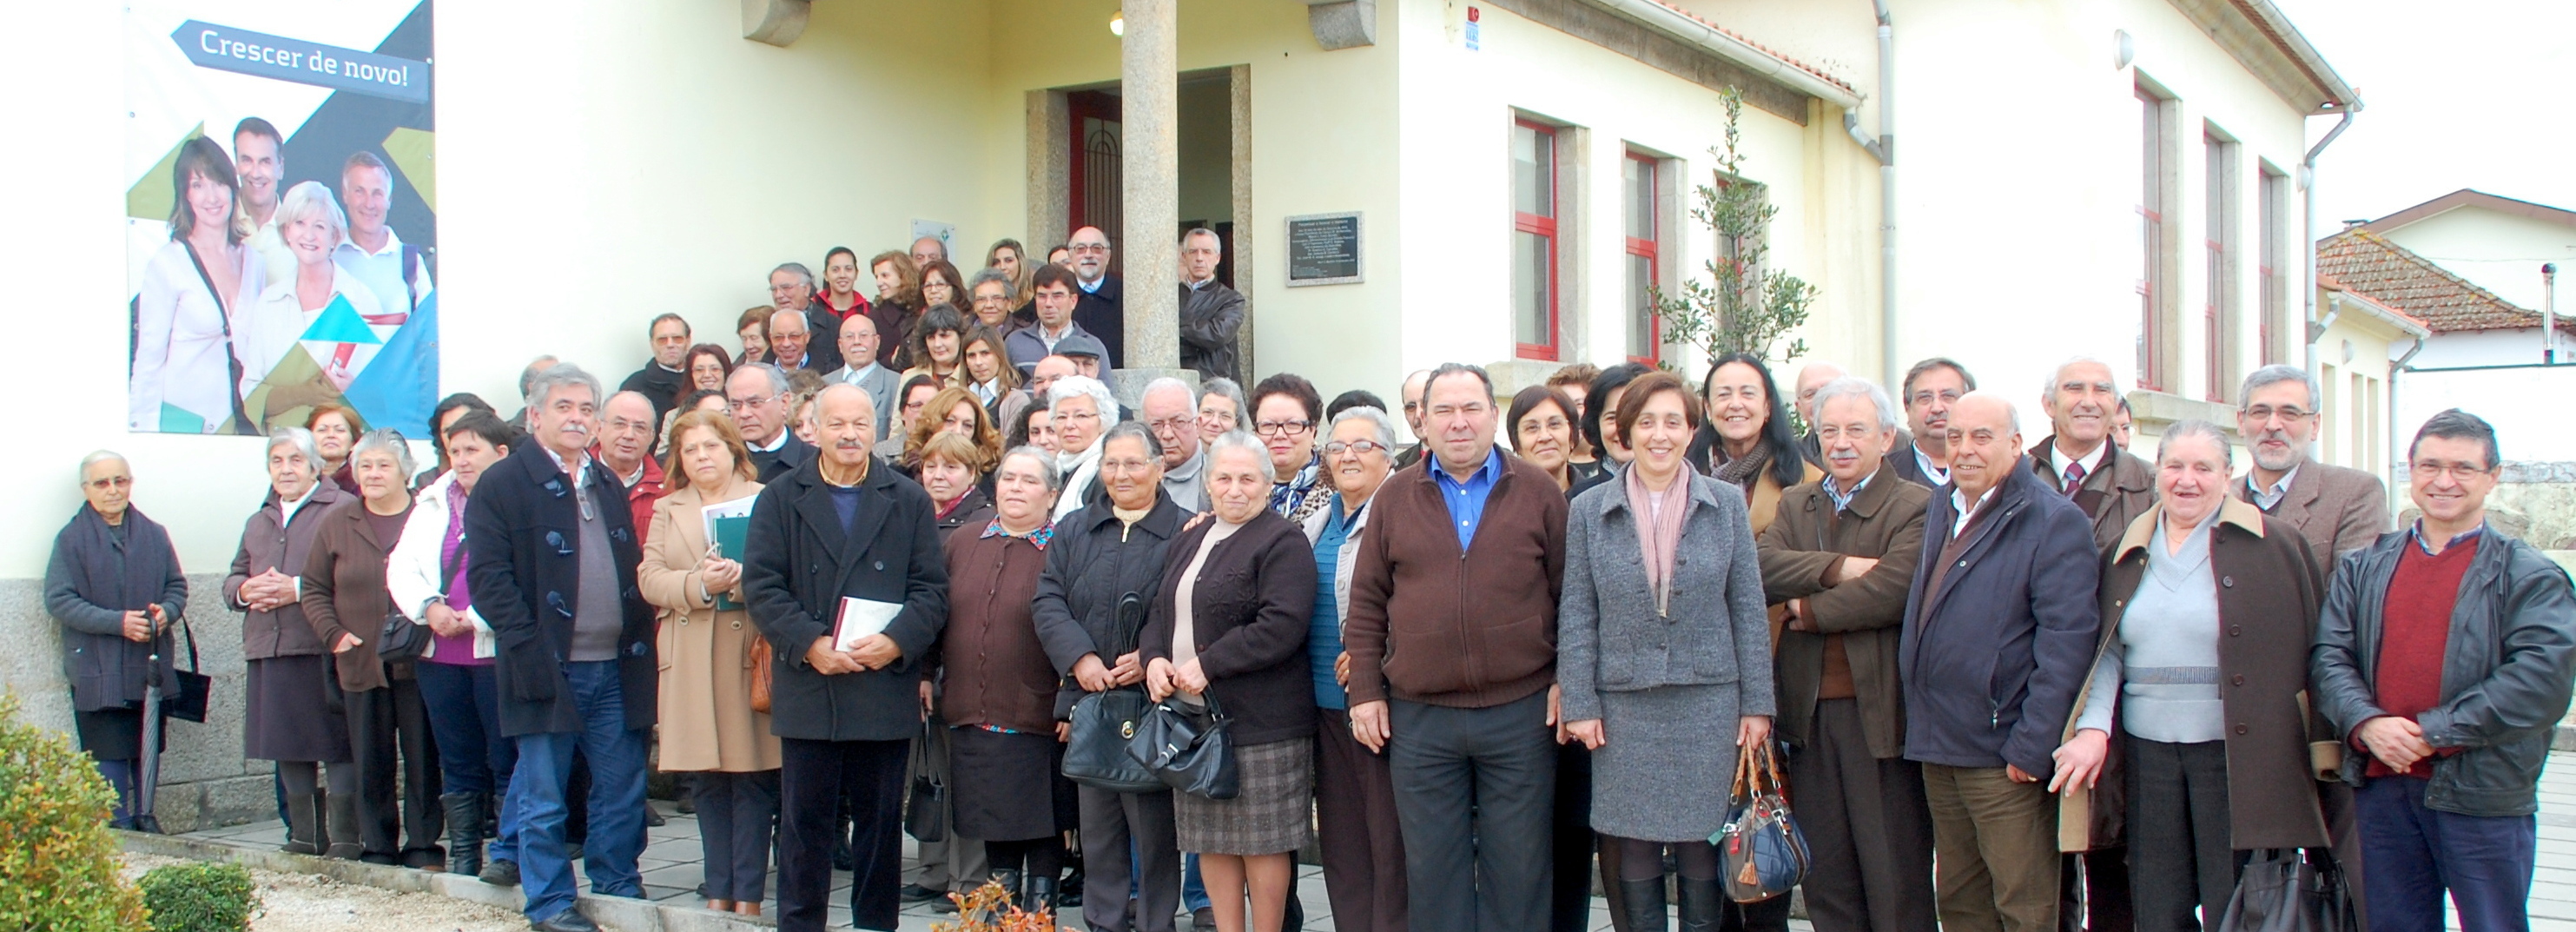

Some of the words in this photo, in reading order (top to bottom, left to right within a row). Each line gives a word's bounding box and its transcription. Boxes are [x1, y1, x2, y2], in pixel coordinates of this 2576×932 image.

[201, 30, 303, 69] Crescer
[309, 50, 338, 75] de
[344, 61, 408, 87] novo!
